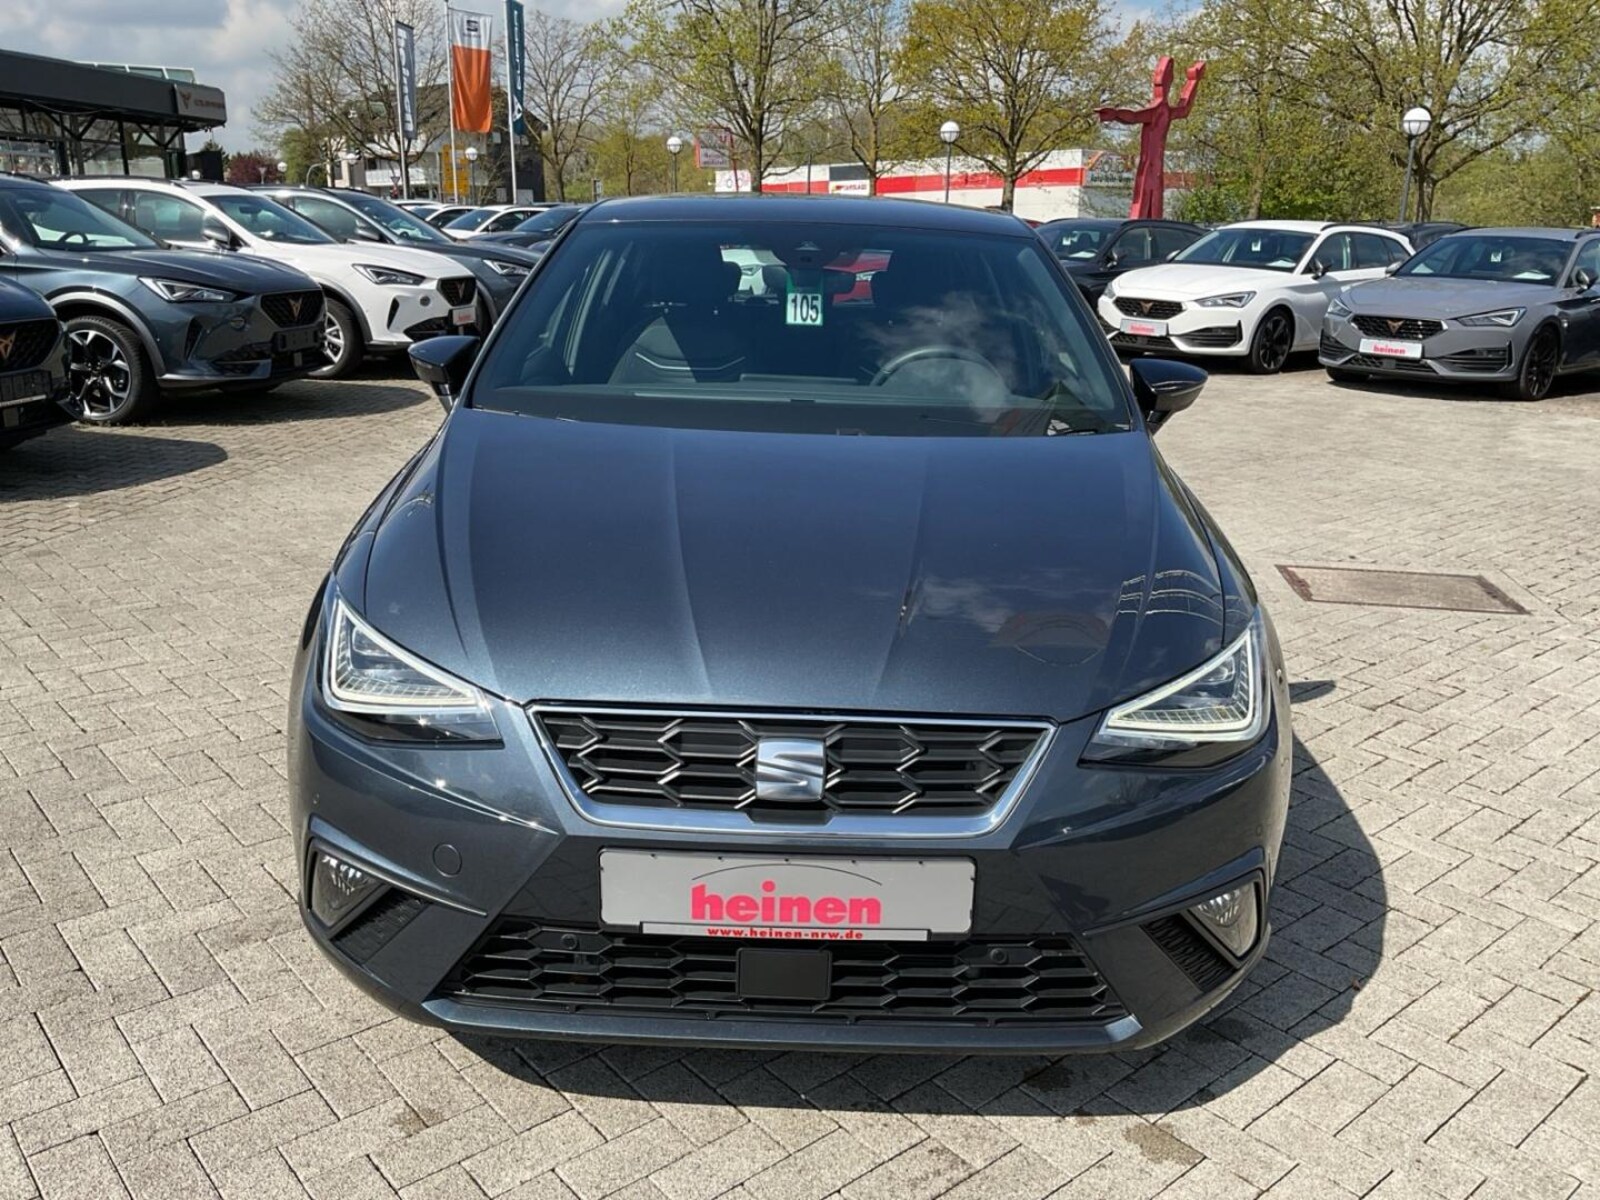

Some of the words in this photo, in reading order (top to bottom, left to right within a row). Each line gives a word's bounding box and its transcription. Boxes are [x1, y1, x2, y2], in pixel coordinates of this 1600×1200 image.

[791, 294, 819, 323] 105
[691, 880, 882, 925] heinen
[707, 927, 864, 940] www.heinen-nrw.de
